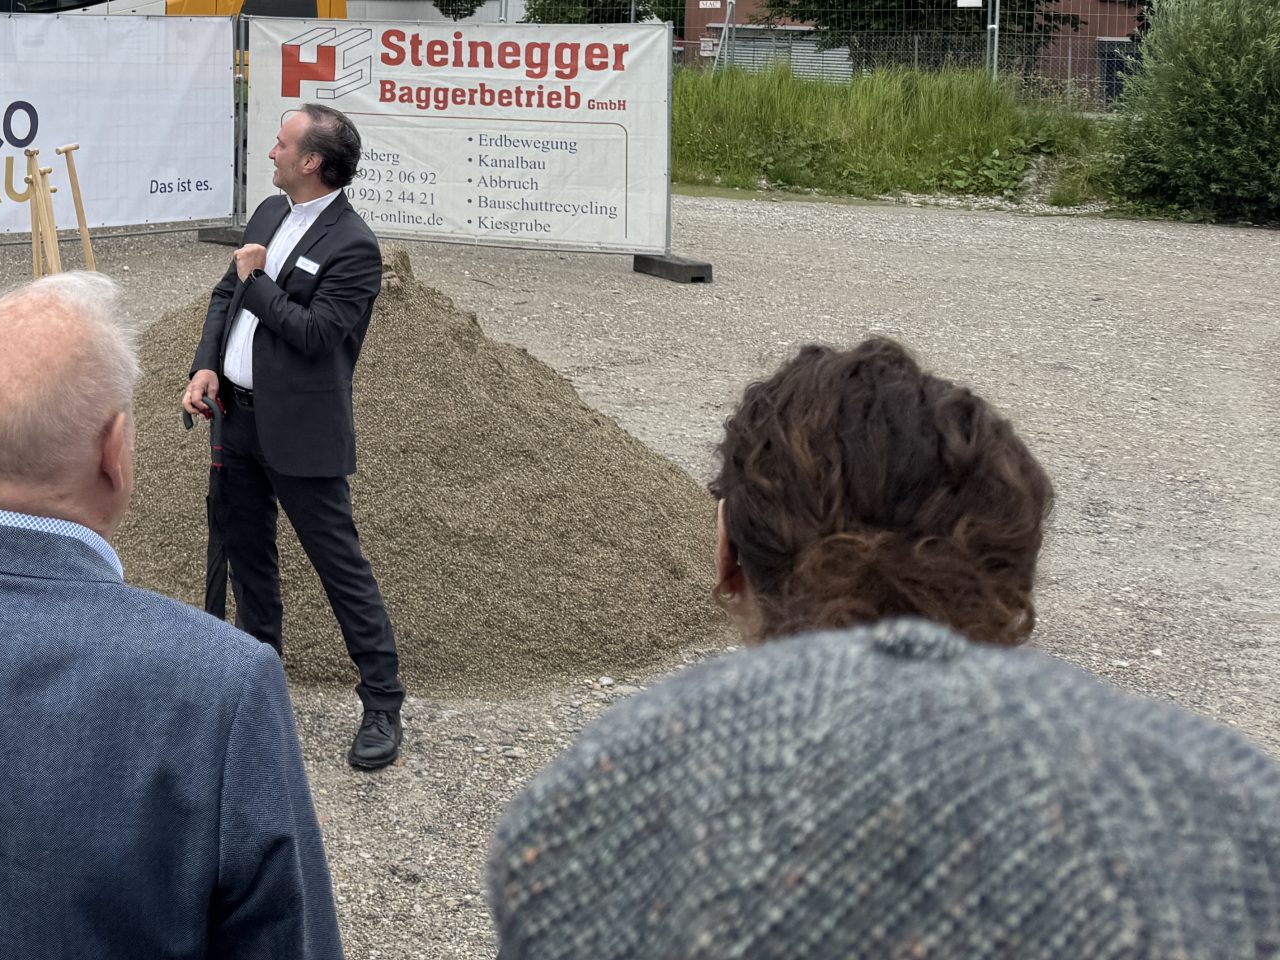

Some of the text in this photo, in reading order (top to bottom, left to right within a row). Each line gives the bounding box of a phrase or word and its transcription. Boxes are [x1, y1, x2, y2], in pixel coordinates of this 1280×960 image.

[380, 28, 630, 80] Steinegger
[378, 79, 628, 112] Baggerbetrieb GmbH
[478, 133, 578, 154] Erdbewegung
[360, 148, 401, 166] rsberg
[478, 154, 547, 171] Kanalbau
[149, 177, 214, 194] Das ist es.
[385, 169, 394, 183] 2
[398, 170, 416, 184] 06
[420, 171, 437, 185] 92
[476, 175, 540, 191] Abbruch
[385, 189, 394, 203] 2
[397, 190, 416, 204] 44
[419, 191, 435, 205] 21
[477, 195, 618, 219] Bauschuttrecycling
[357, 207, 444, 227] @t-online.de
[478, 215, 552, 234] Kiesgrube
